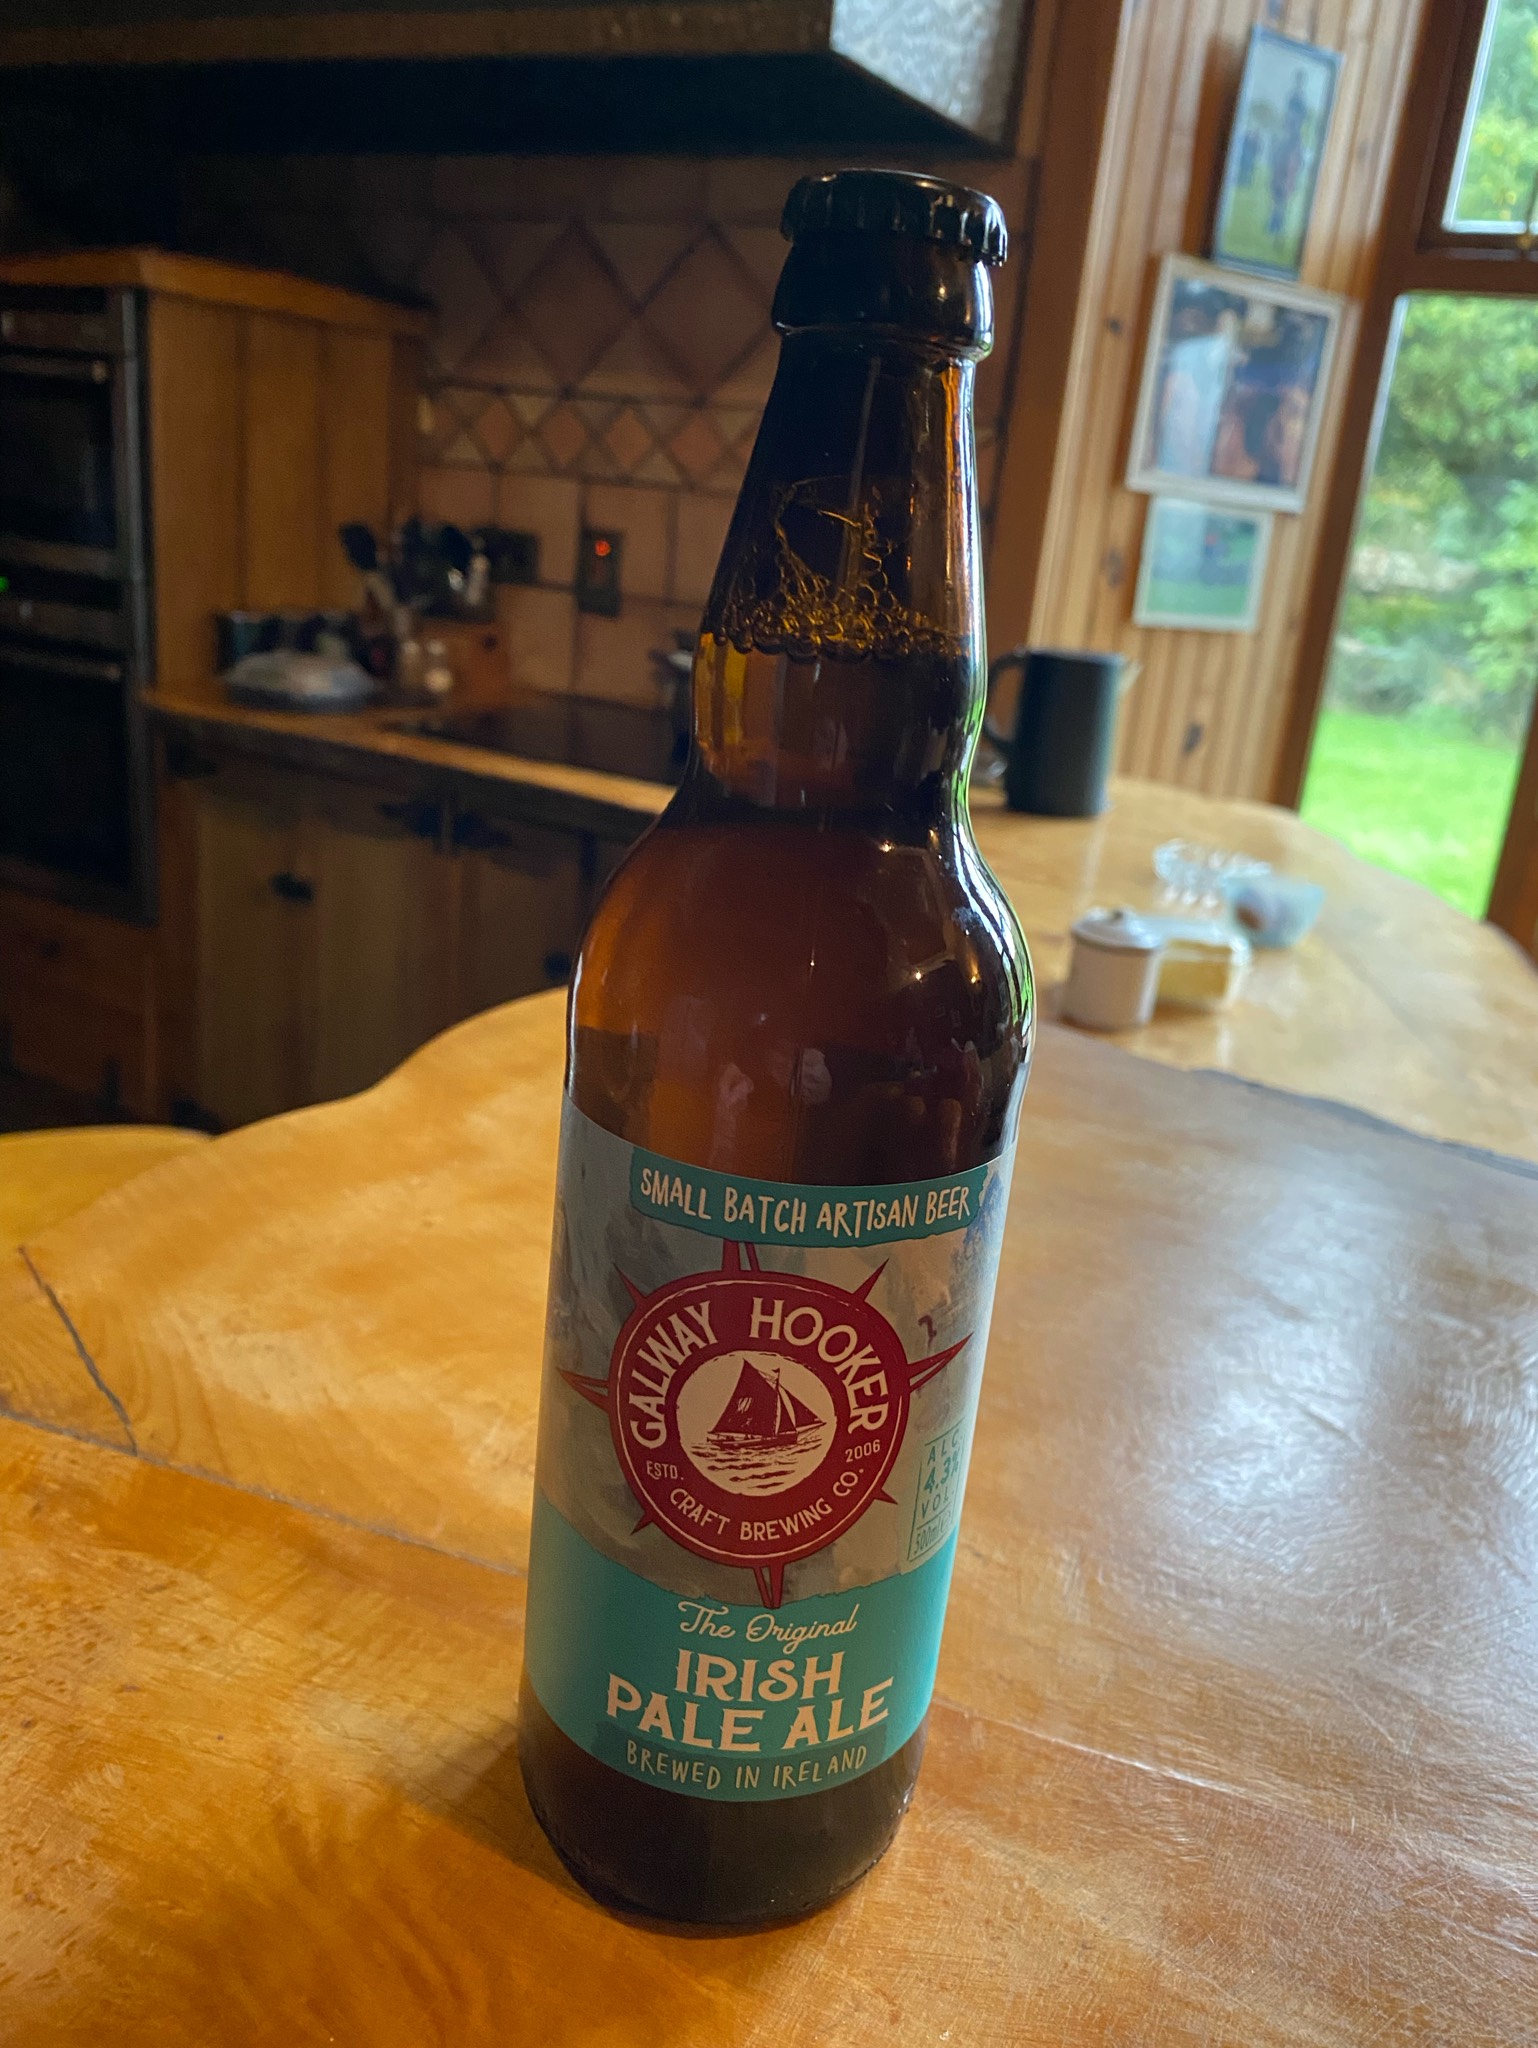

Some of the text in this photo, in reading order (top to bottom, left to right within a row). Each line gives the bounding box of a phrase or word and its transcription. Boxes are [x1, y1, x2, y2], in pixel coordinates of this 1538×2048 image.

[640, 1167, 971, 1238] SMALL BATCH ARTISAN BEER
[628, 1297, 889, 1449] GALWAY HOOKER
[646, 1460, 684, 1482] ESTD.
[845, 1439, 881, 1463] 2006
[924, 1447, 961, 1494] 4.3%
[669, 1487, 731, 1536] CRAFT
[740, 1497, 833, 1541] BREWING
[677, 1600, 860, 1655] The Original
[675, 1647, 845, 1702] IRISH
[606, 1672, 895, 1752] PALE ALE
[626, 1739, 868, 1790] BREWED IN IRELAND
